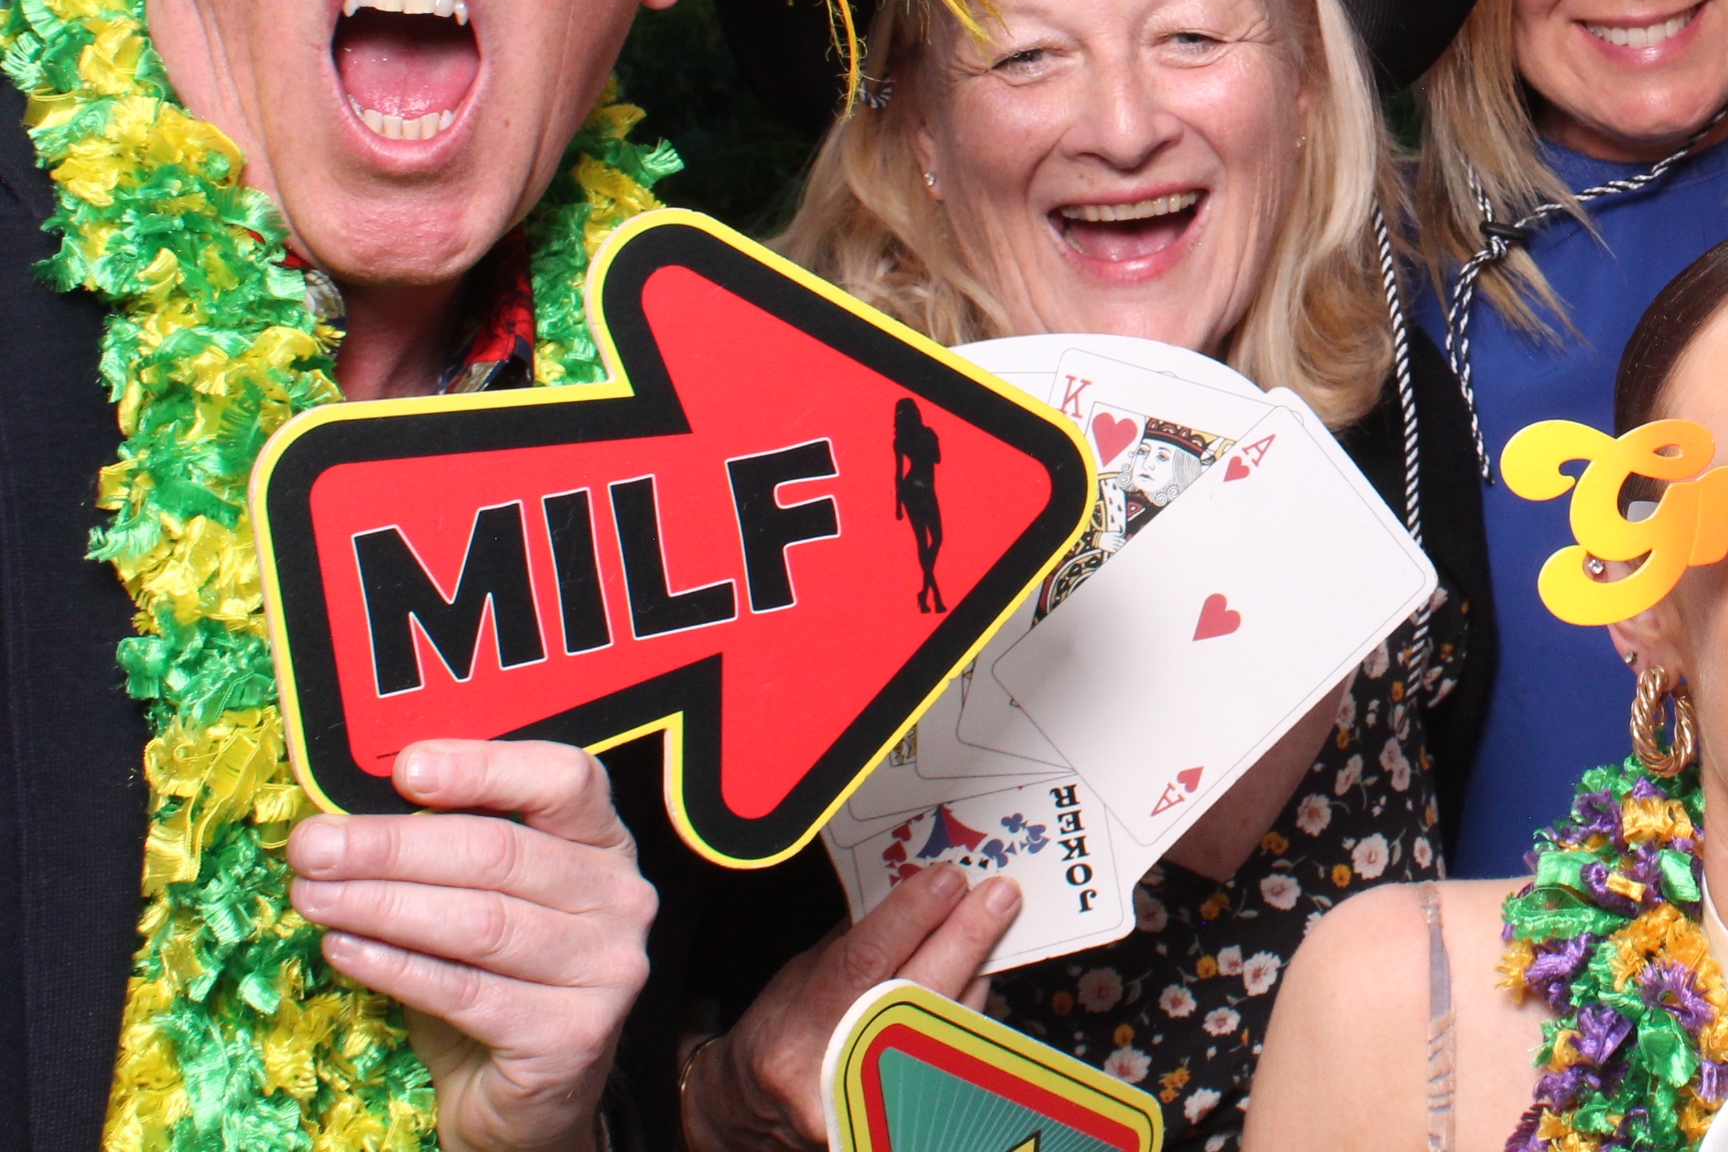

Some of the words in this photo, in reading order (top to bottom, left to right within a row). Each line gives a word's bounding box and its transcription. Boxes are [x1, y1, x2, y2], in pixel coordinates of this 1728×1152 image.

[1057, 374, 1092, 419] K
[1242, 433, 1276, 467] A
[351, 437, 841, 699] MILF
[1150, 782, 1186, 818] A
[1049, 783, 1098, 914] JOKER
